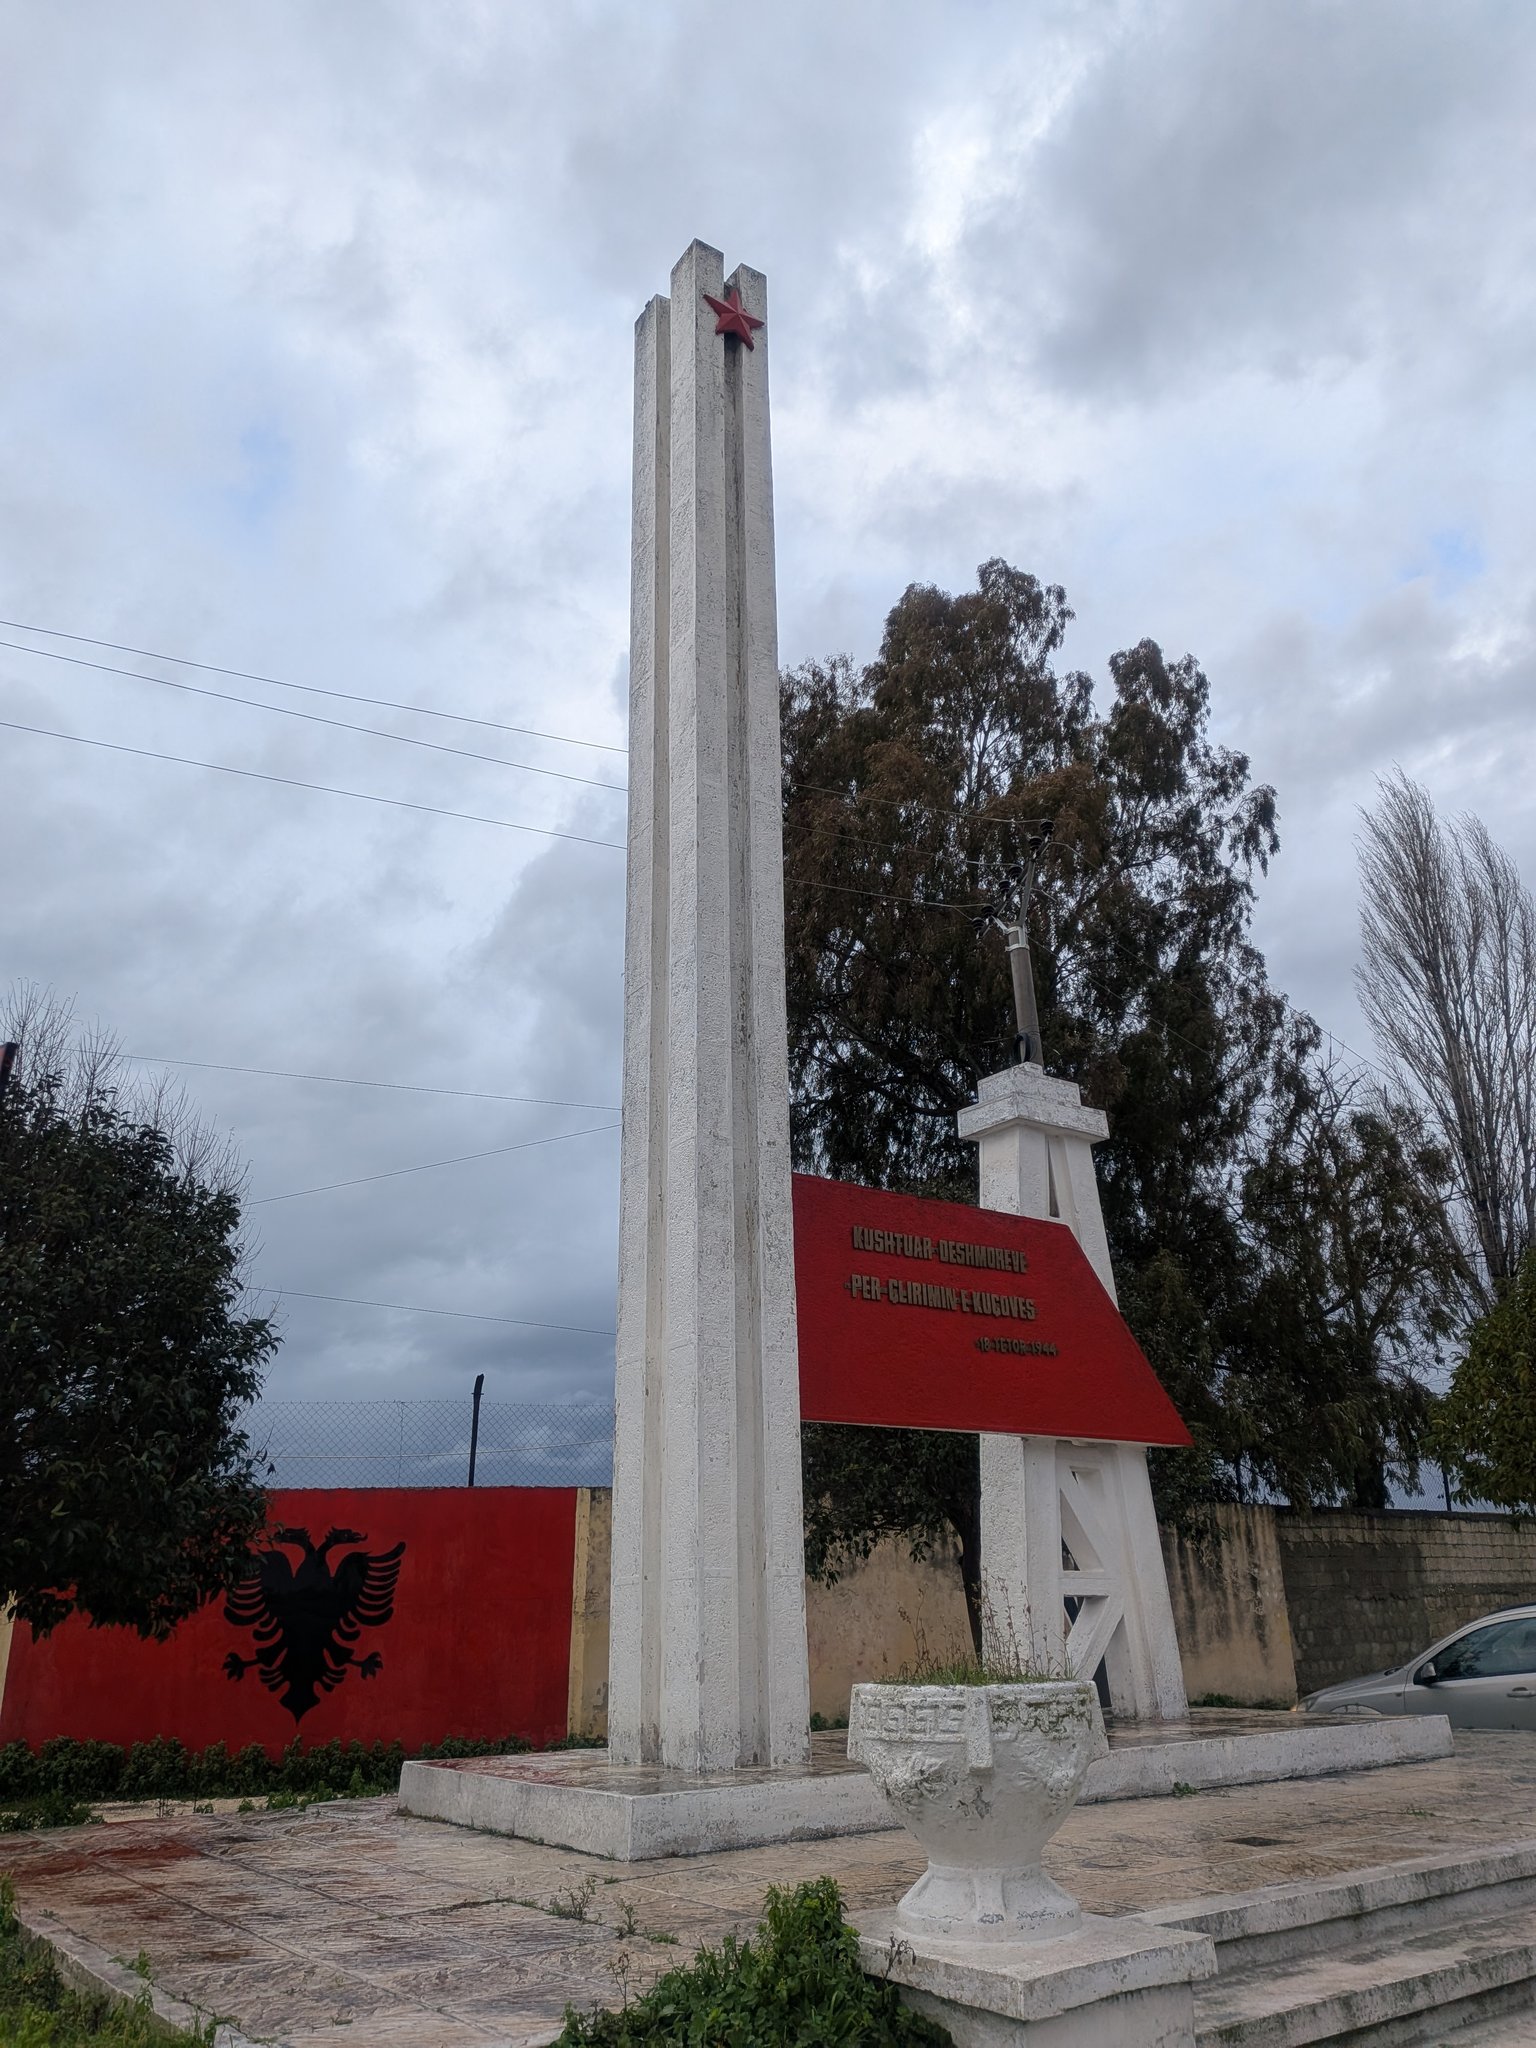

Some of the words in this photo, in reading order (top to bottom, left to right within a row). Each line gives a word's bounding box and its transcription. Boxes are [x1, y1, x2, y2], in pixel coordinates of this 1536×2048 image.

[852, 1226, 933, 1260] KUSHTUAR
[851, 1274, 881, 1300] PER
[961, 1289, 970, 1312] E
[1031, 1339, 1057, 1356] 1944
